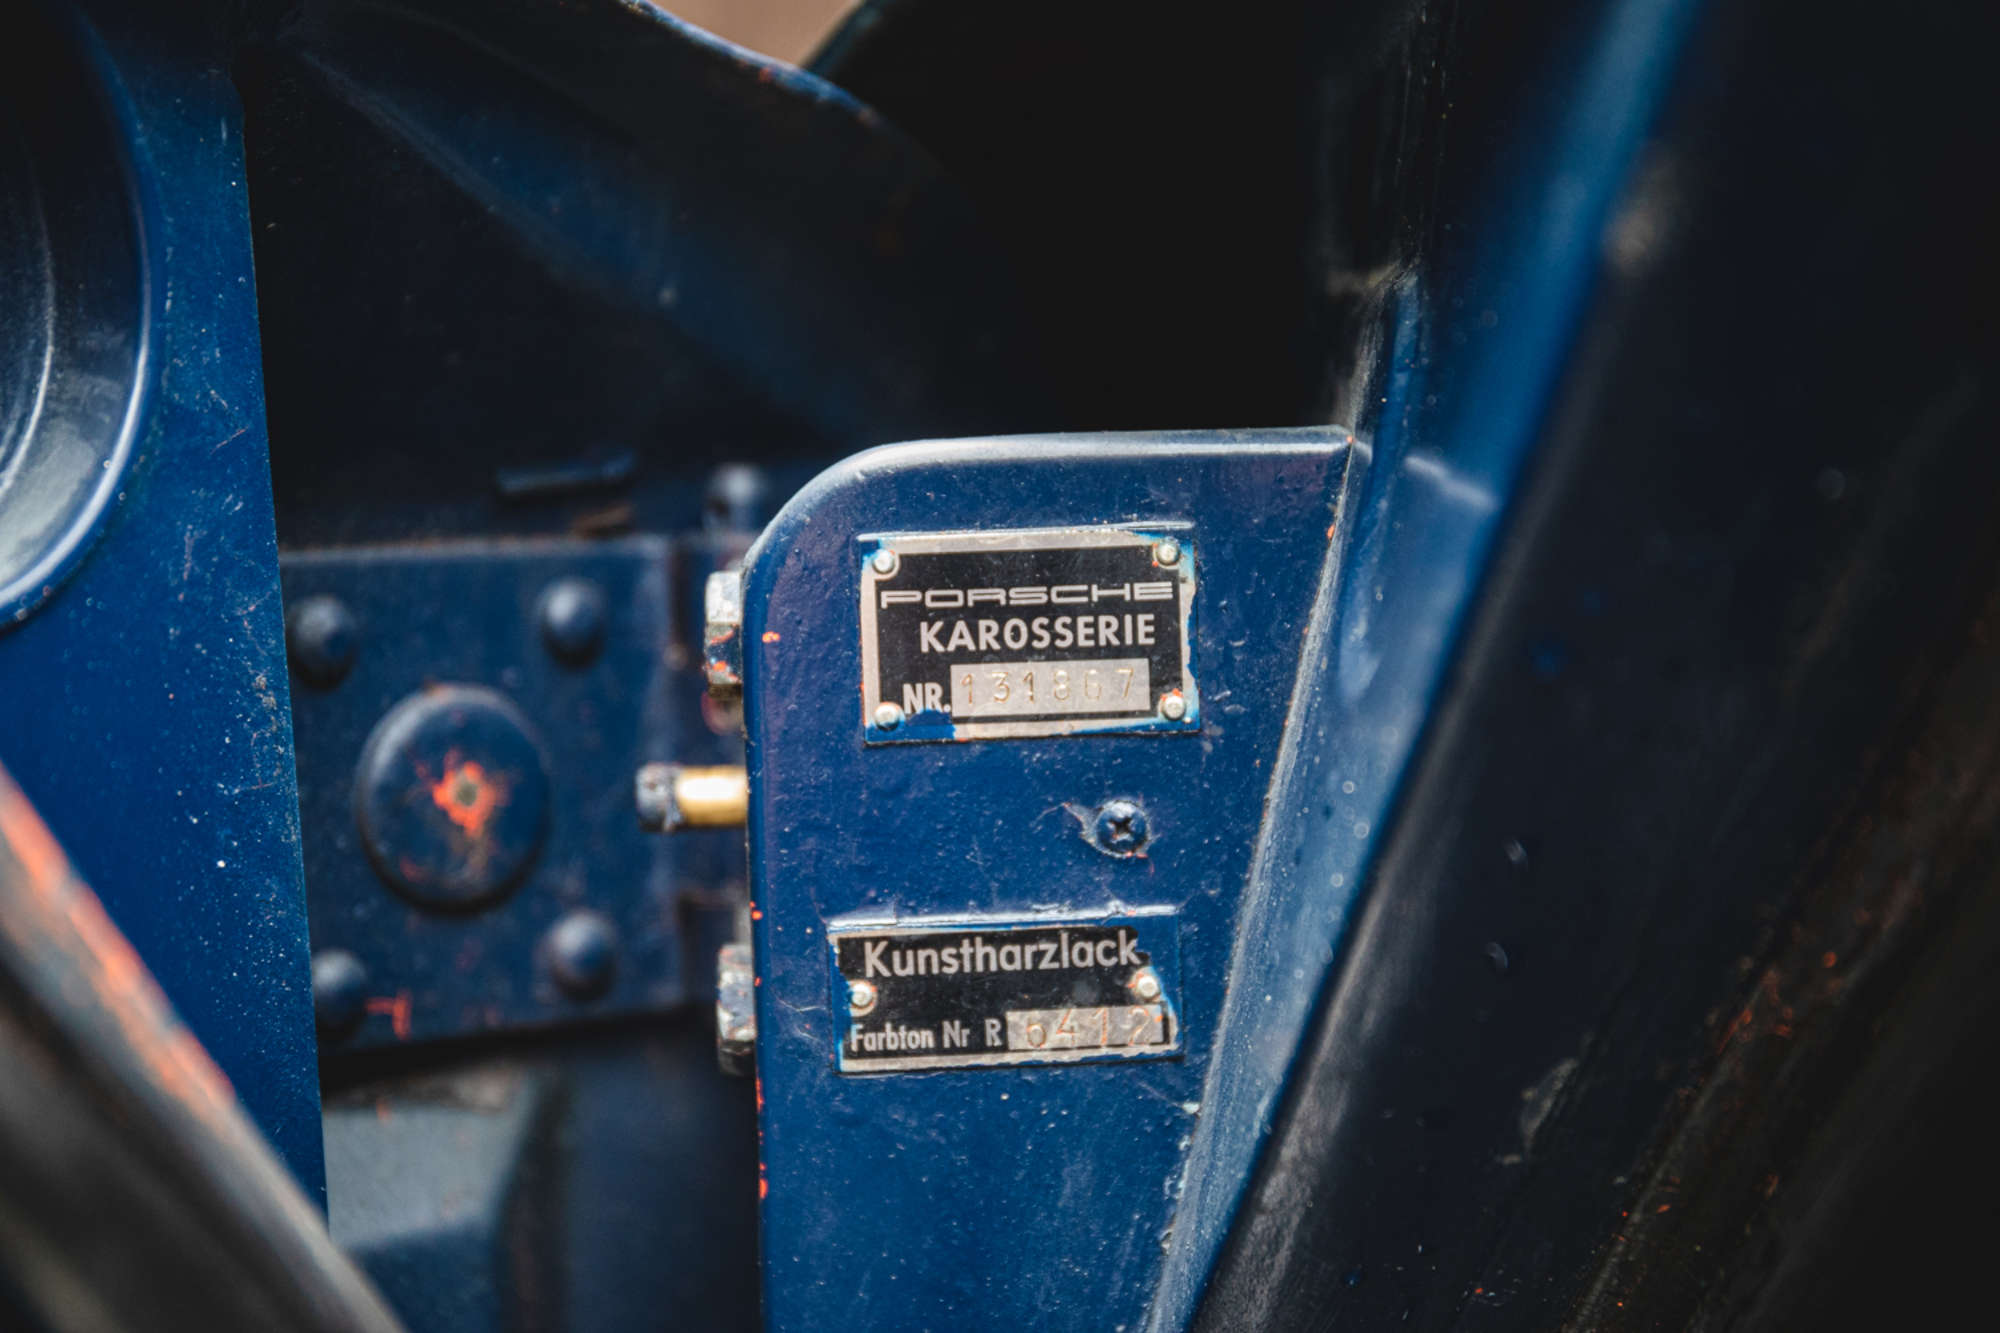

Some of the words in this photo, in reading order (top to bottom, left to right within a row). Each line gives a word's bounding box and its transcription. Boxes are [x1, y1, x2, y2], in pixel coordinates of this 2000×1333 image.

[881, 581, 1173, 609] PORSCHE
[920, 614, 1156, 653] KAROSSERIE
[863, 929, 1141, 978] Kunstharzlack
[850, 1022, 934, 1051] Farbton
[942, 1019, 970, 1049] Nr
[985, 1018, 1002, 1047] R
